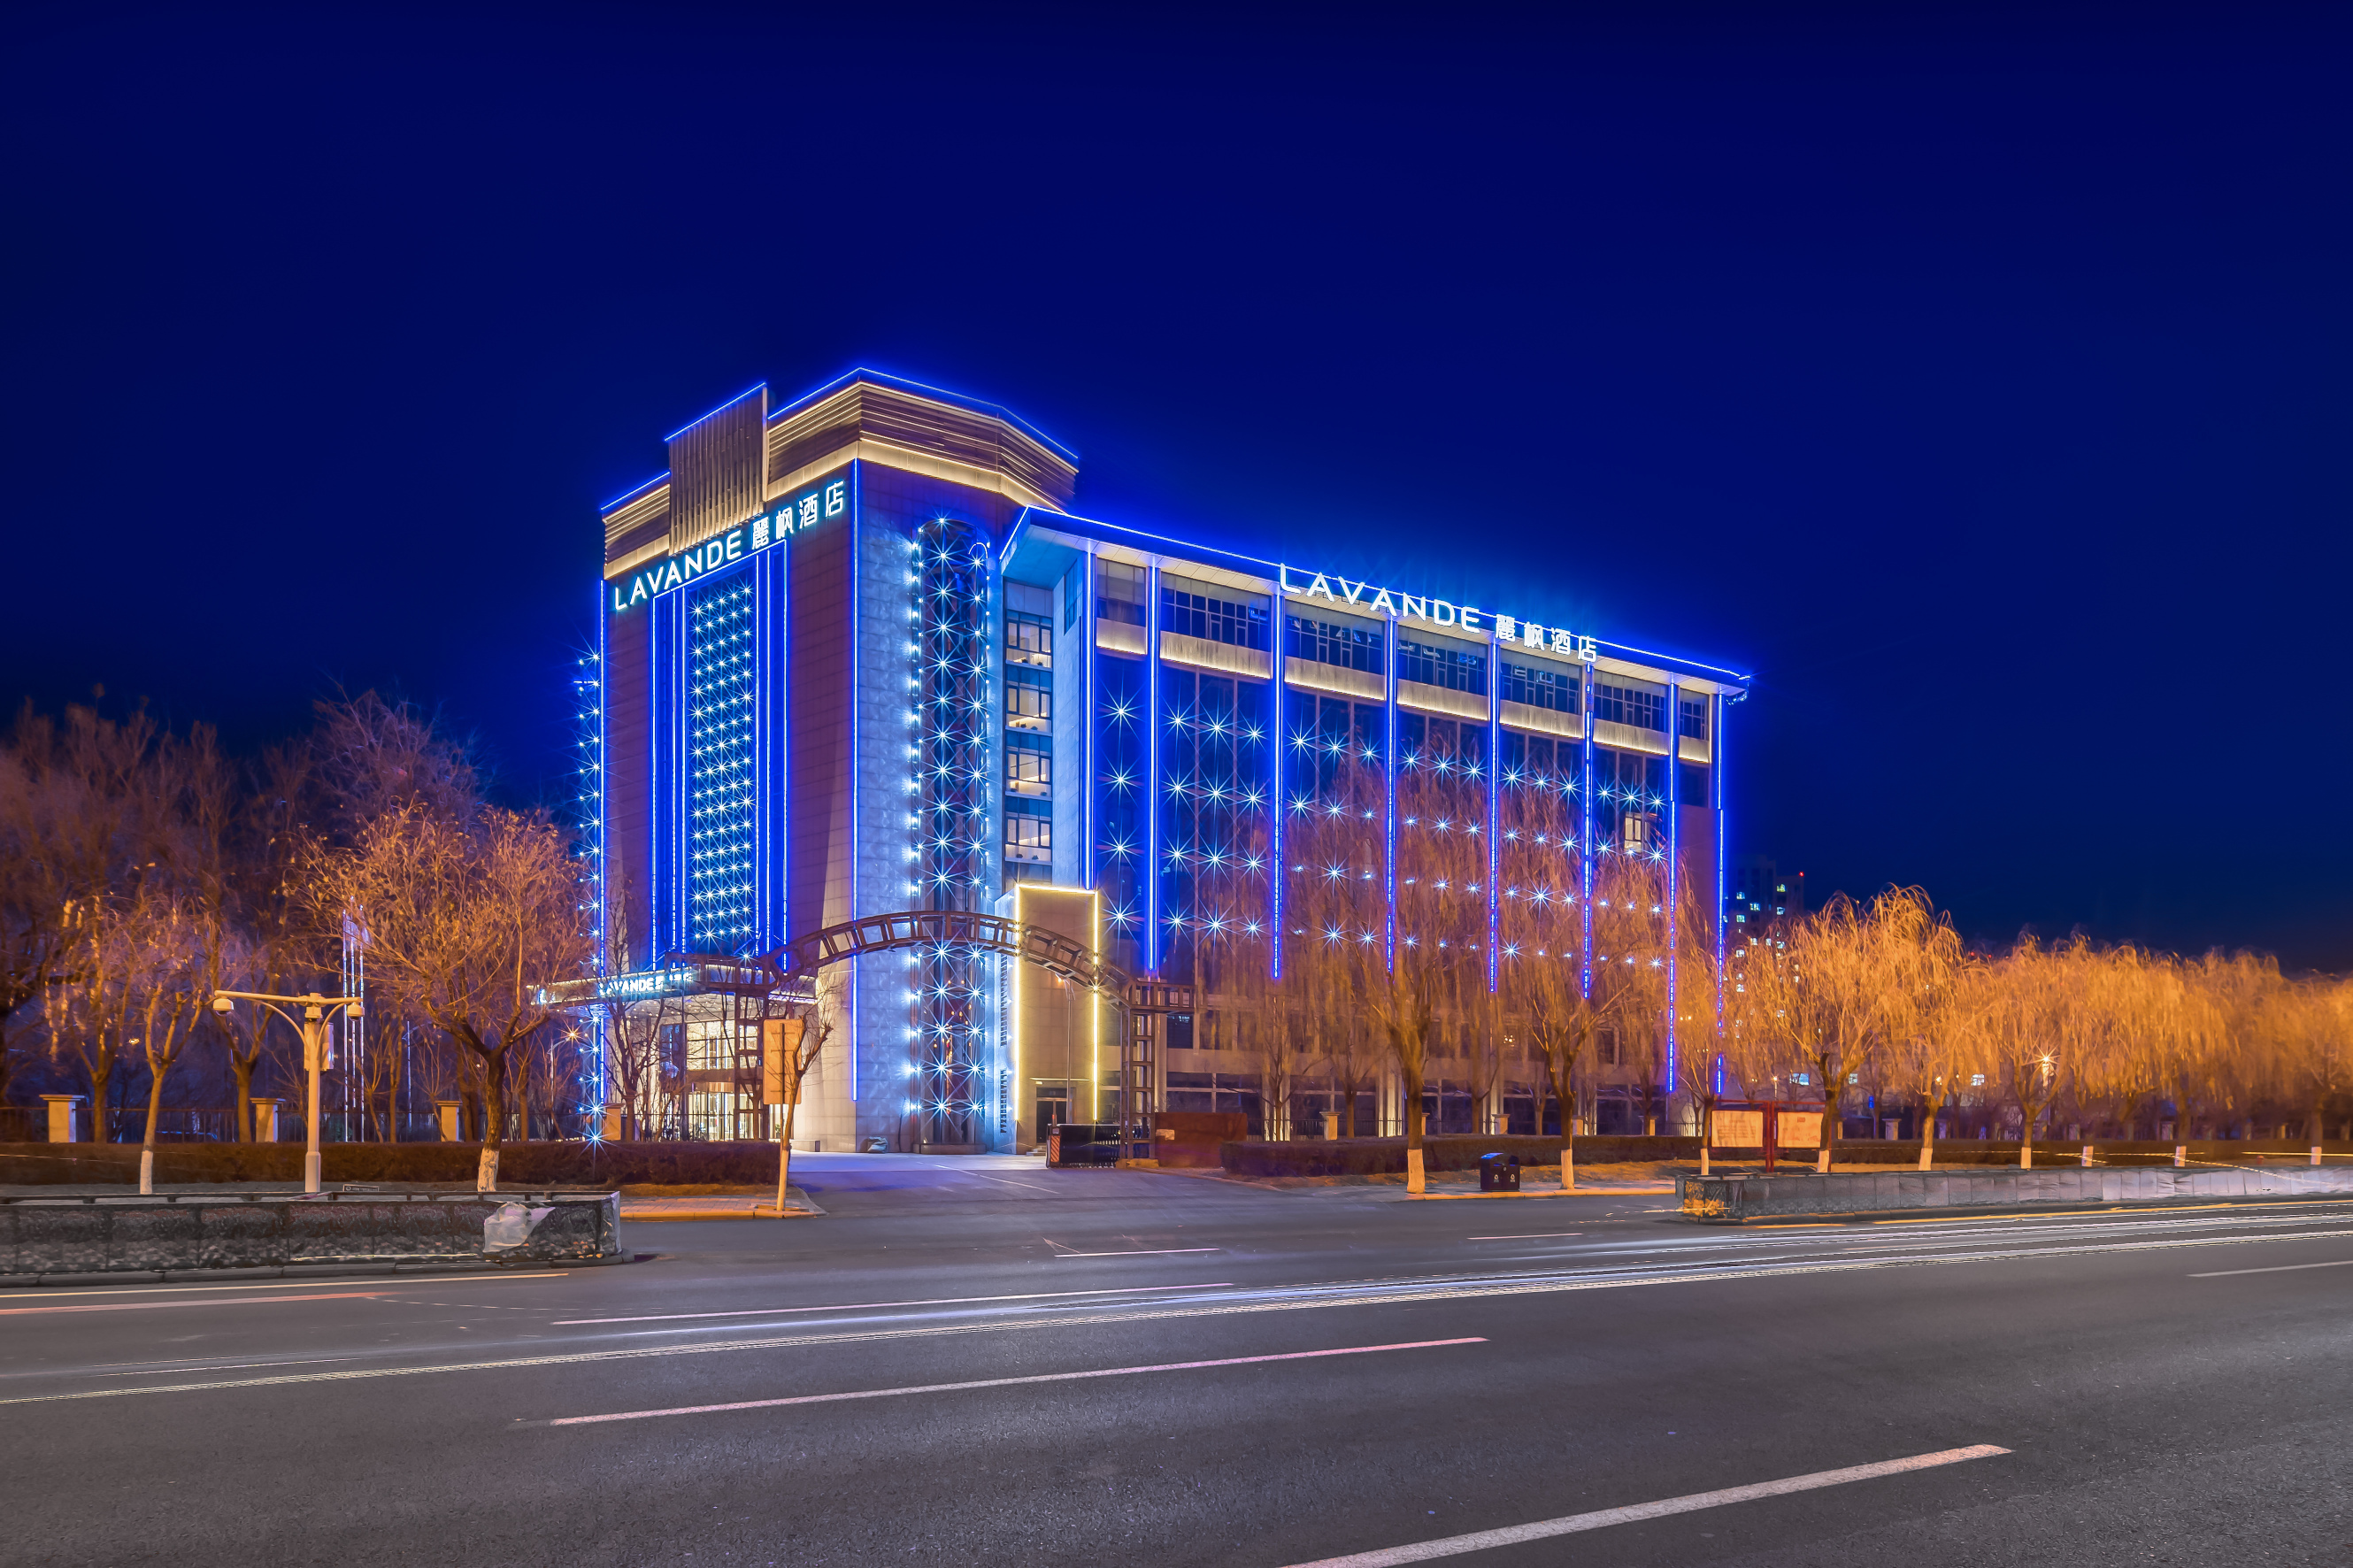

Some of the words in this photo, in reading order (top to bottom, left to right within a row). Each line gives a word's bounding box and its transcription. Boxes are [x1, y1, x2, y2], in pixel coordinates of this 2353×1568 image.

[614, 530, 742, 611] LAVANDE
[1280, 563, 1481, 634] LAVANDE
[598, 977, 654, 997] LAVANDE
